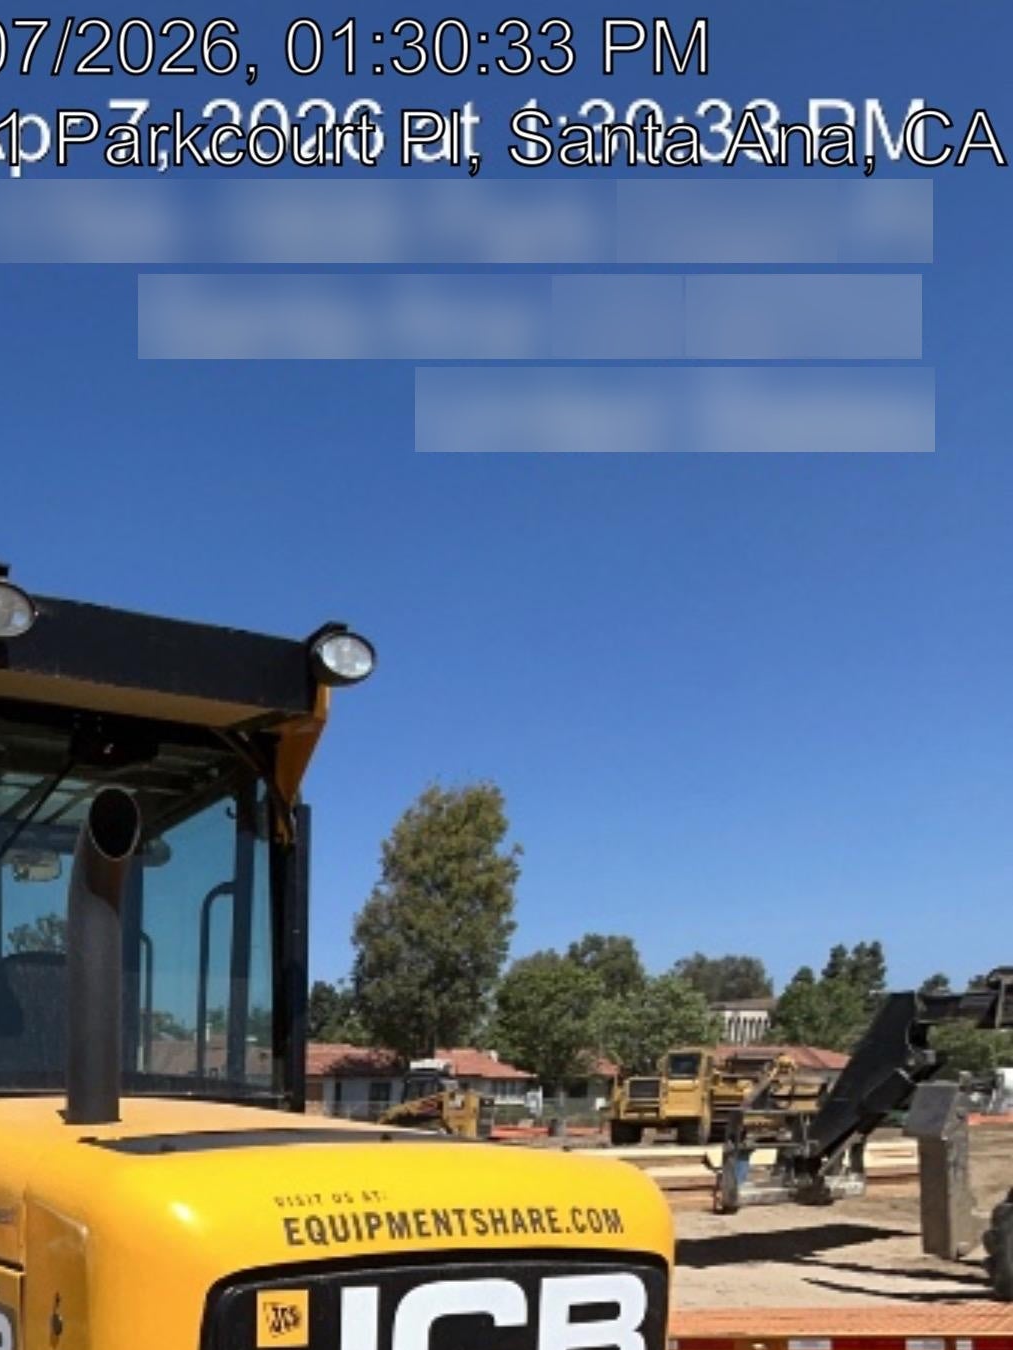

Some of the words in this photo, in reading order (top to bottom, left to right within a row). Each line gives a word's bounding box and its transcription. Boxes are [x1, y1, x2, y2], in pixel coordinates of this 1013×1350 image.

[273, 1192, 322, 1208] VISIT
[331, 1190, 354, 1204] US
[283, 1207, 625, 1247] EQUIPMENTSHARE.COM
